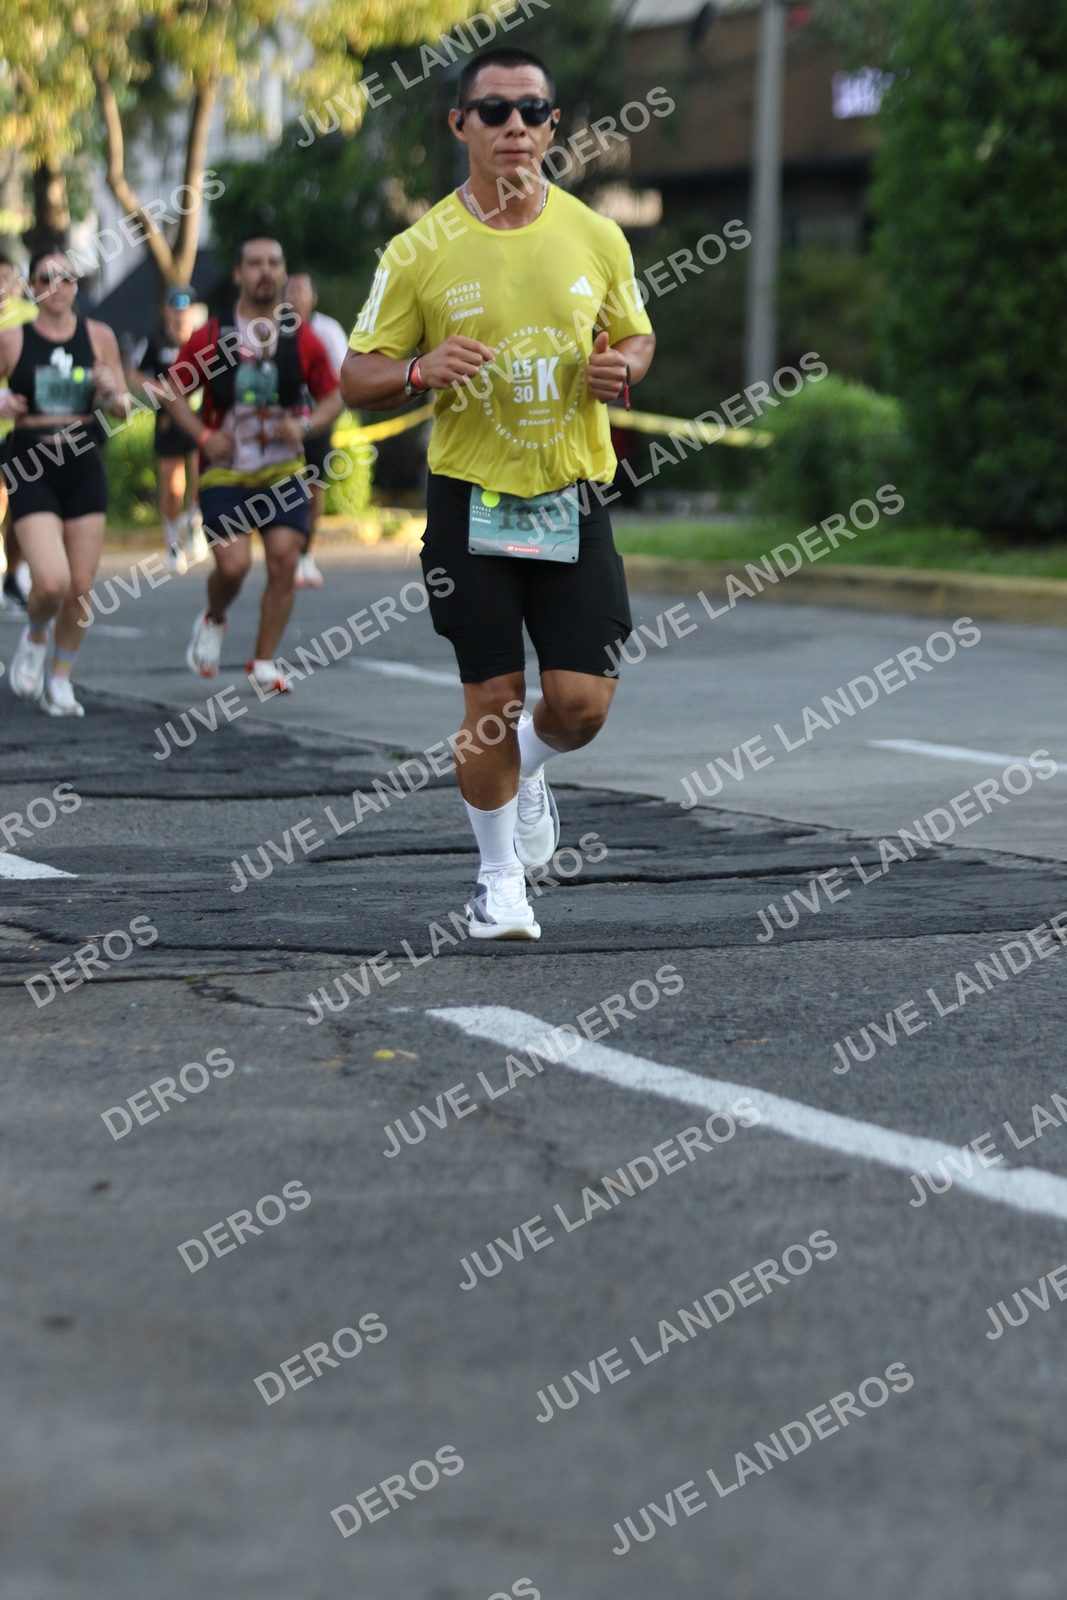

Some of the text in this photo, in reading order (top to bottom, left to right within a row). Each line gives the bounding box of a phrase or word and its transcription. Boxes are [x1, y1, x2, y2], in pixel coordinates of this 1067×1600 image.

[512, 359, 533, 378] 15
[537, 357, 560, 401] K
[513, 385, 534, 404] 30
